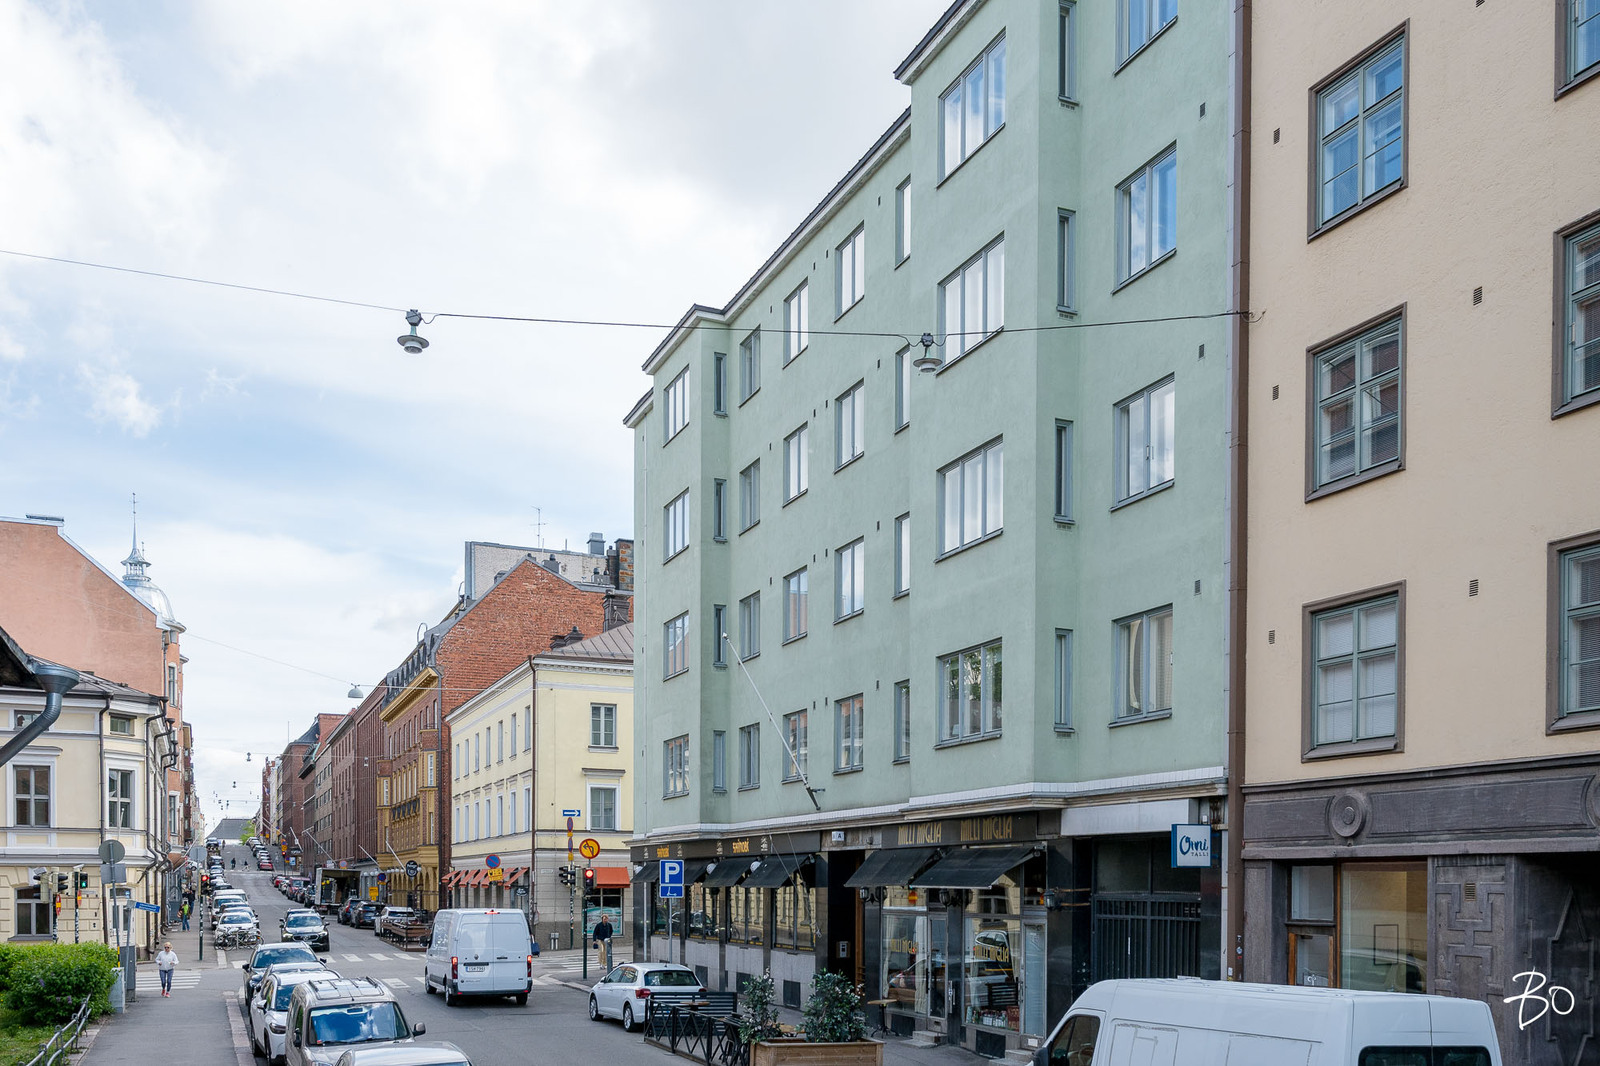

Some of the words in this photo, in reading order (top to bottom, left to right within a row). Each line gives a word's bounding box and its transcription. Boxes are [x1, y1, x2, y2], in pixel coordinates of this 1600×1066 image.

[898, 824, 915, 845] MILLI
[917, 821, 942, 844] MIGLIA
[960, 818, 980, 841] MILLI
[983, 816, 1012, 840] MIGLIA
[665, 863, 680, 883] P
